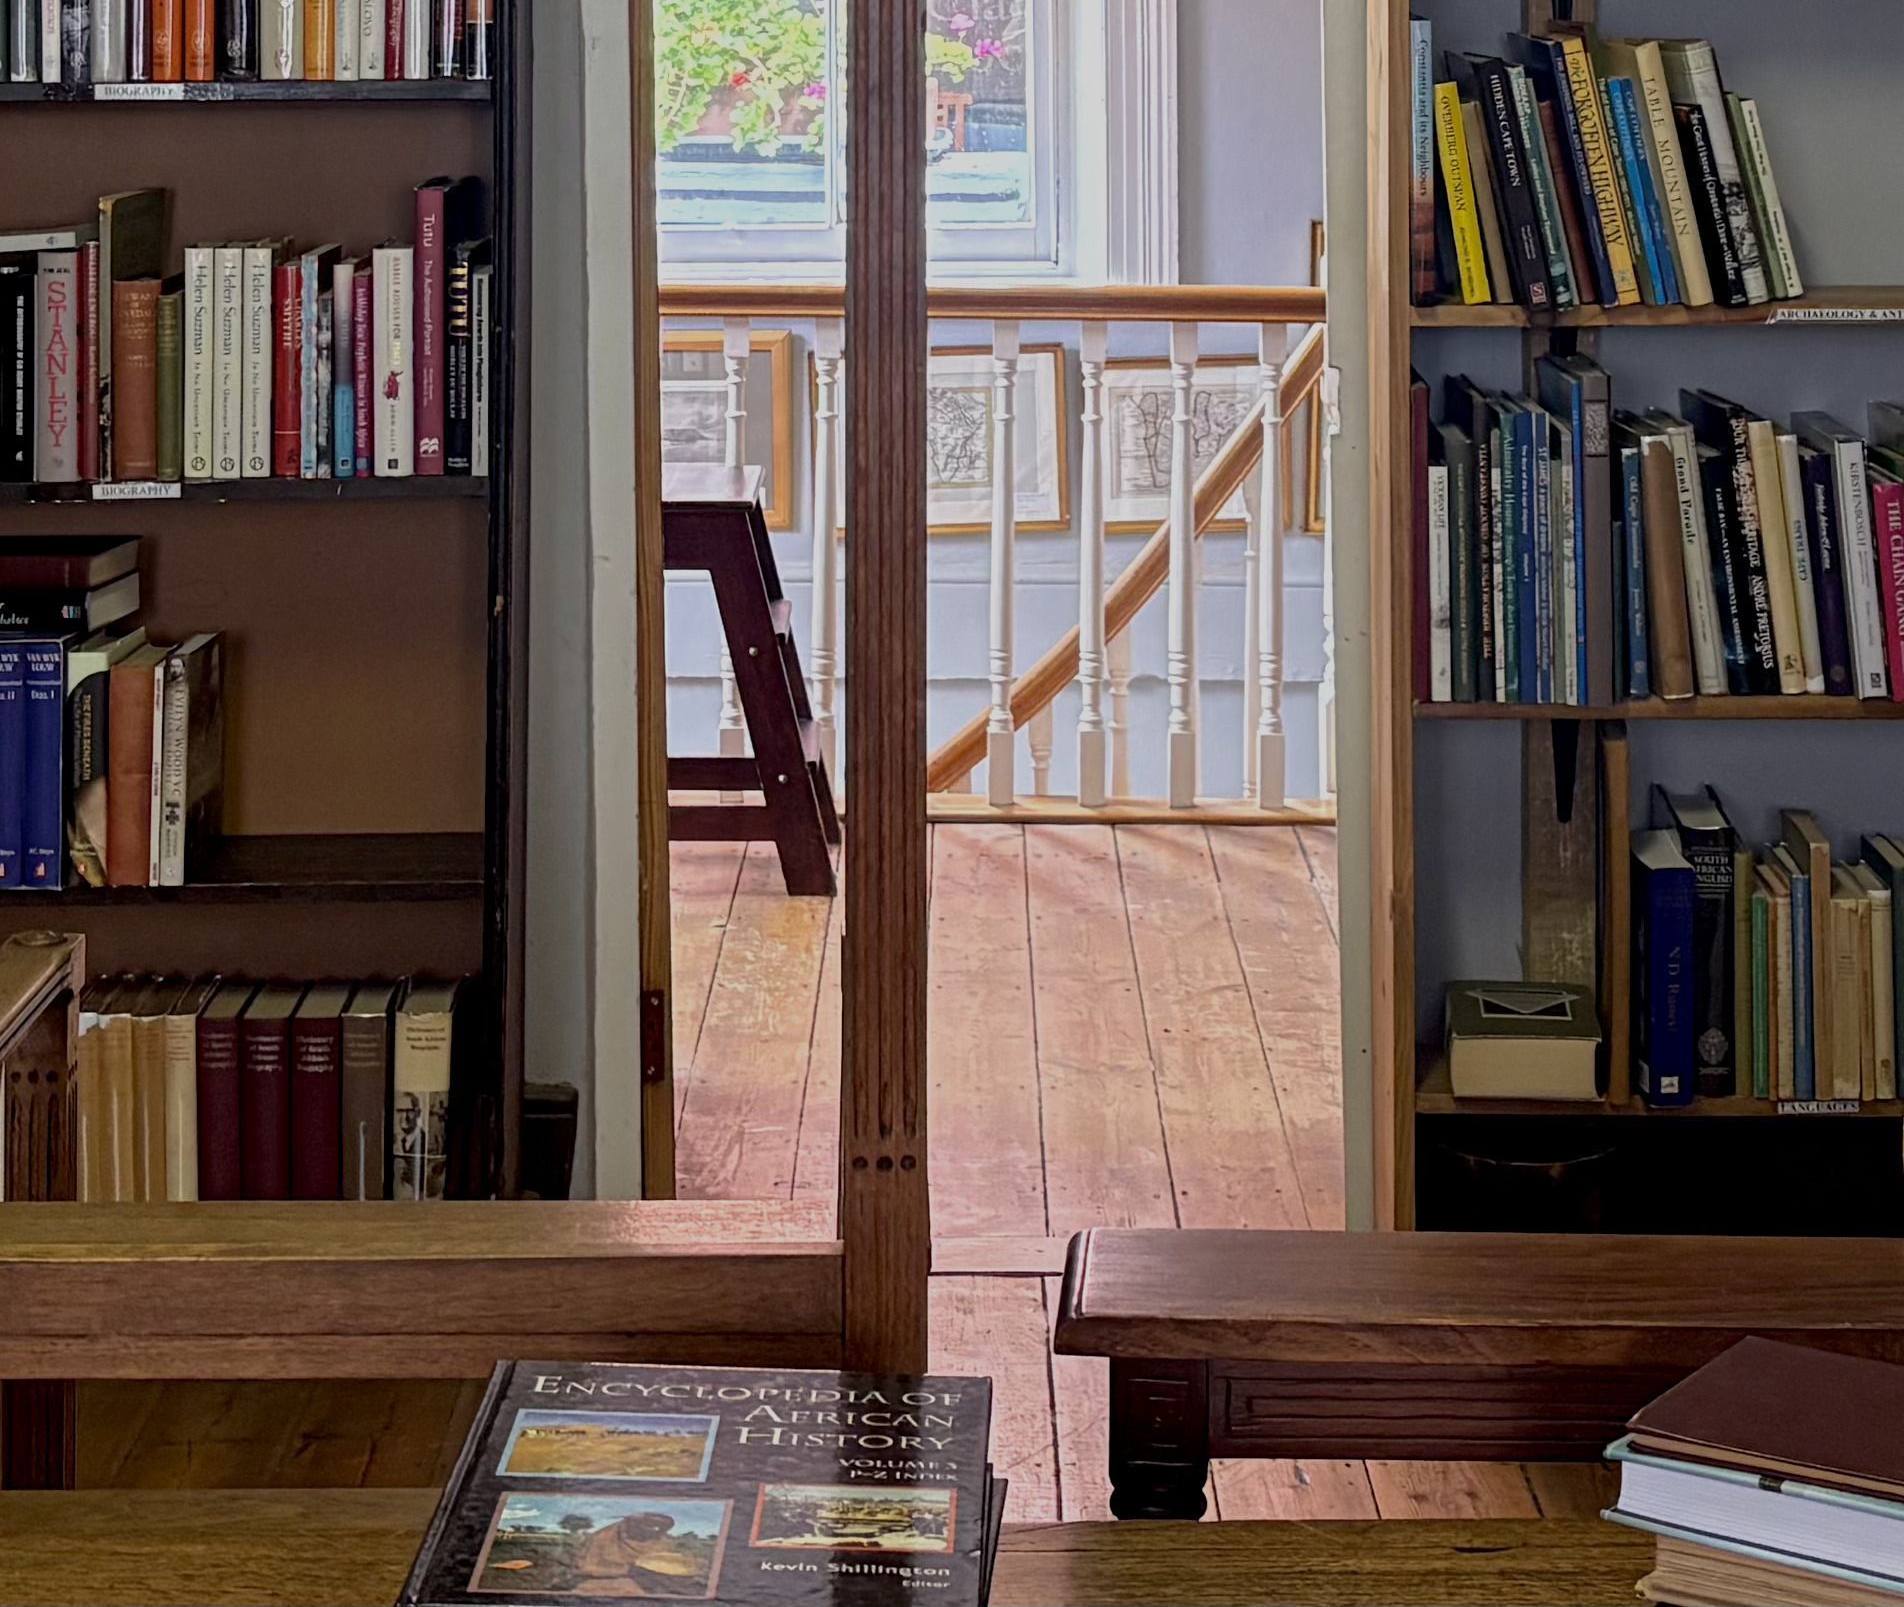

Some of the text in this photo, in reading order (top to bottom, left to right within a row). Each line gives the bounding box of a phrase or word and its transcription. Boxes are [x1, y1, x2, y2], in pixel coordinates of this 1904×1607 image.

[1416, 39, 1429, 196] Constantia and its Neighbours
[1488, 74, 1520, 187] HIDDEN CAPE TOWN
[1440, 96, 1466, 211] OVERBERG OUTSPAN
[1572, 78, 1623, 247] FORGOTTEN HIGHWAY
[1643, 76, 1689, 237] TABLE MOUNTAIN
[422, 213, 435, 276] Tutu The
[447, 261, 467, 337] TUTU
[1779, 309, 1866, 320] ARCHAEOLOGY
[193, 305, 206, 355] Suzman
[223, 305, 236, 355] Suzman
[251, 305, 264, 355] Suzman
[45, 281, 67, 447] STANLEY
[101, 484, 171, 496] BIOGRAPHY
[1501, 434, 1515, 527] Admiralty House
[1626, 475, 1638, 517] Old Cape
[1675, 457, 1695, 545] Grand Parade
[1848, 461, 1866, 546] KIRSTENBOSCH
[1886, 499, 1901, 531] THE
[533, 1375, 964, 1408] ENCYCLOPEDIA OF
[736, 1426, 953, 1452] HISTORY
[744, 1405, 954, 1429] AFRICAN
[839, 1458, 942, 1470] VOLUME
[760, 1560, 951, 1578] Kevin Shillington
[901, 1579, 951, 1589] Editor
